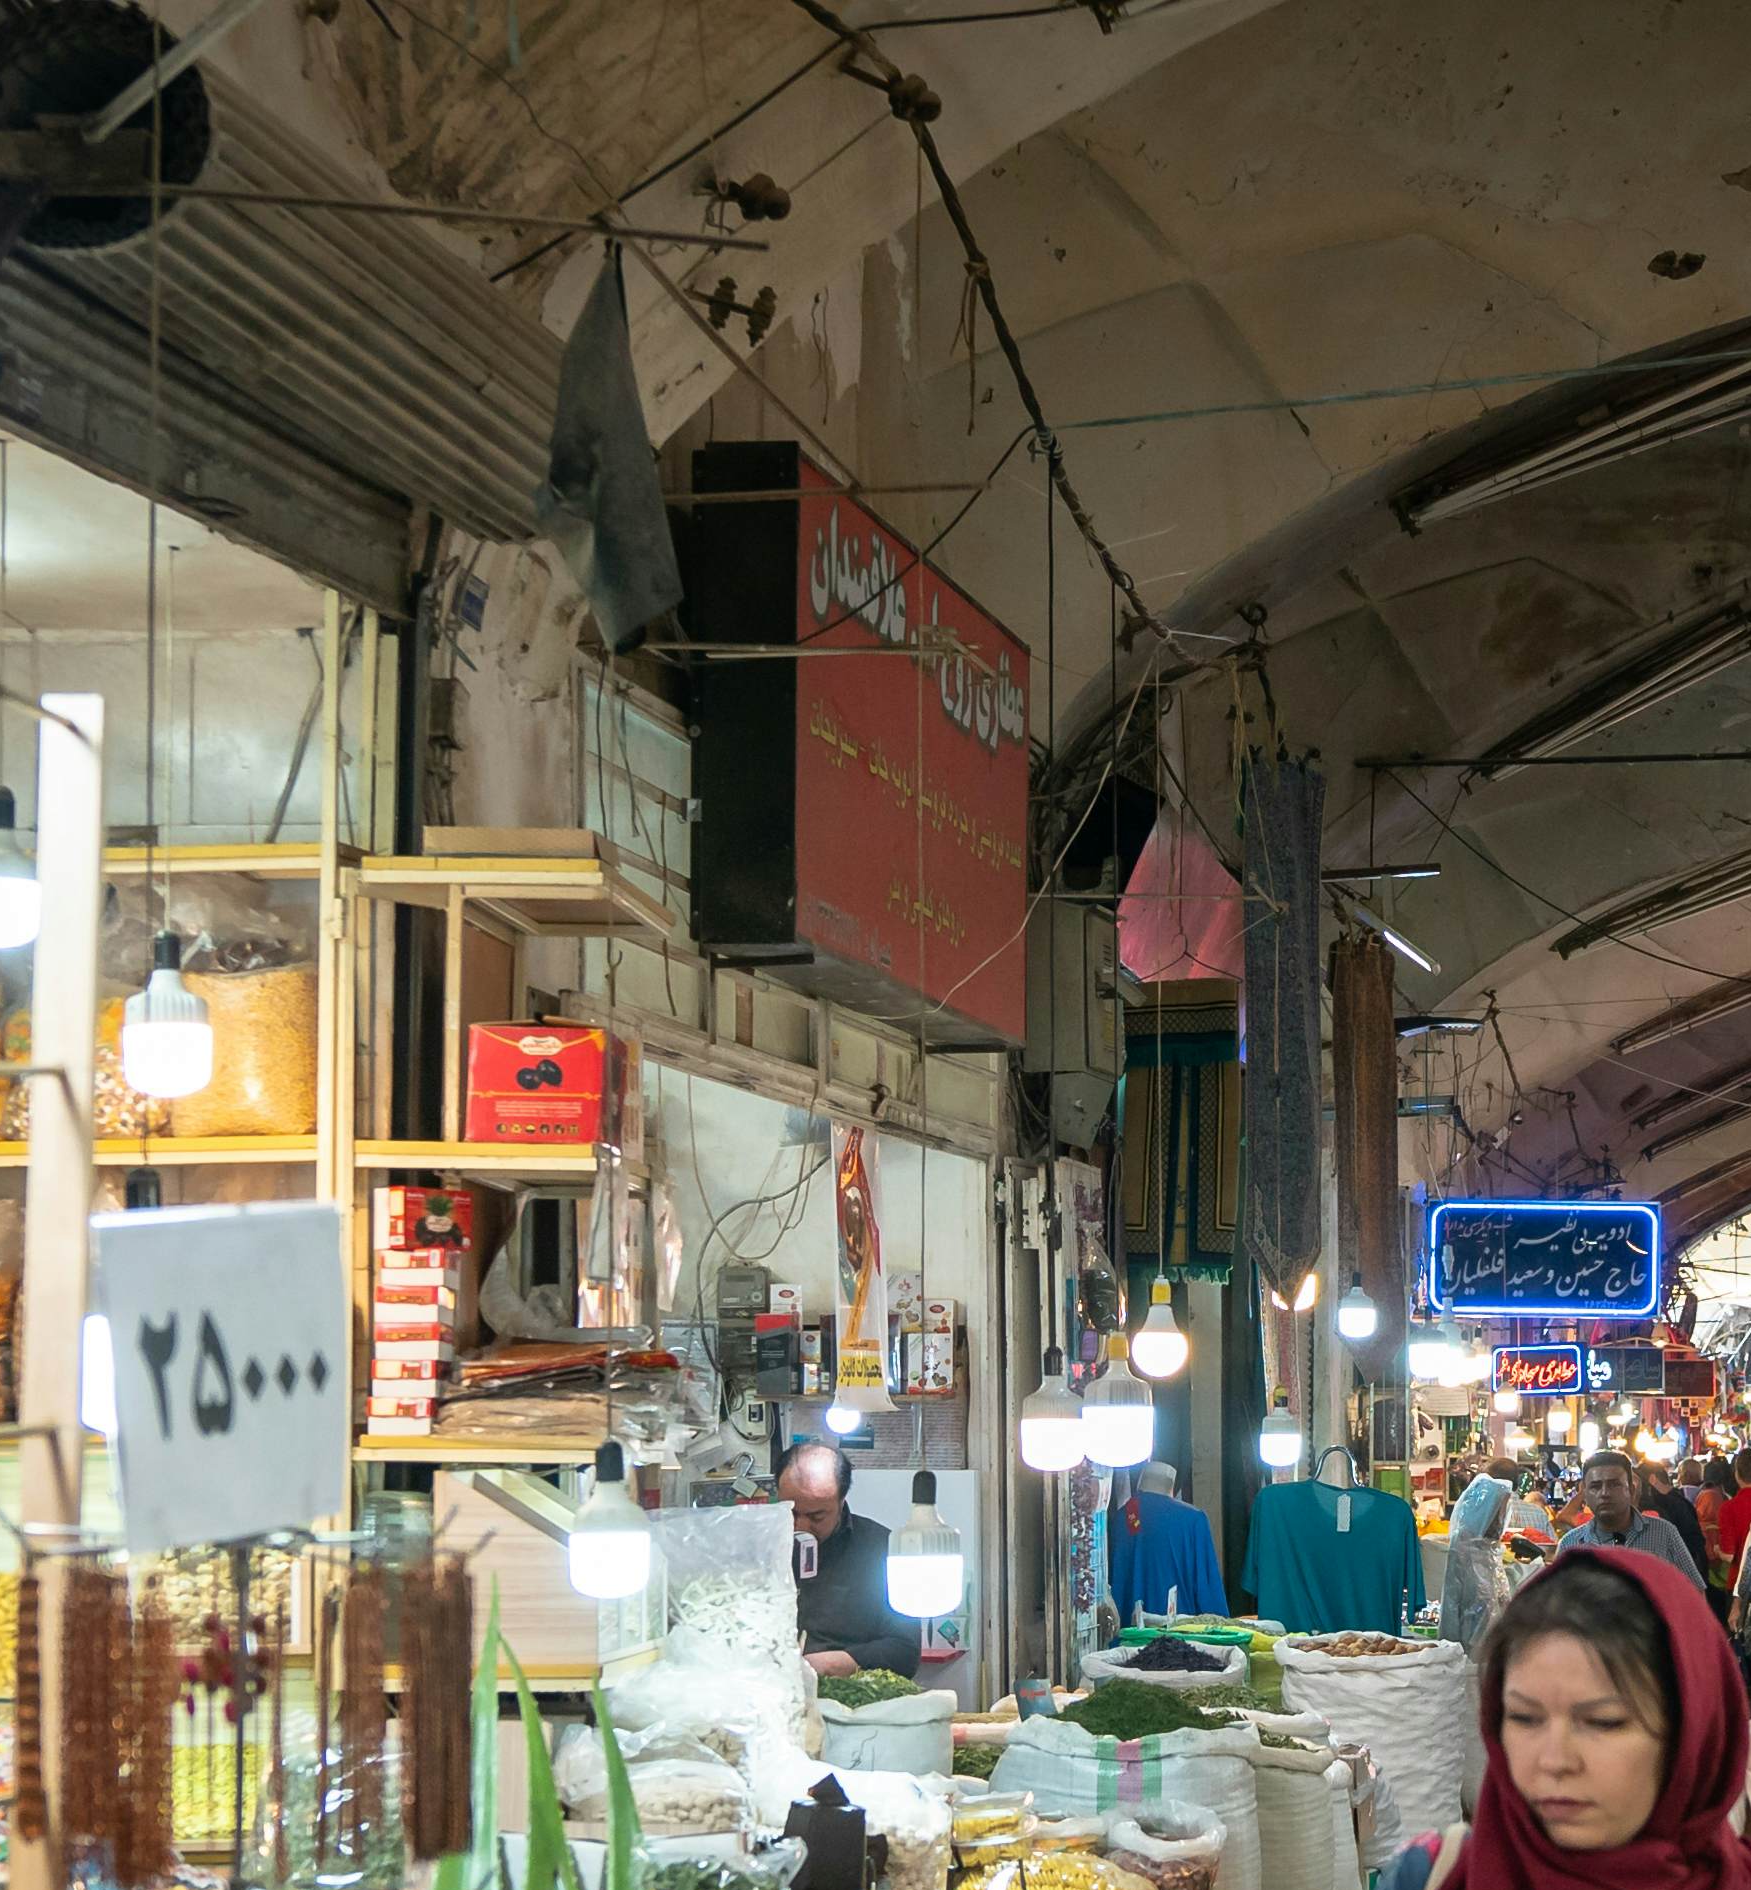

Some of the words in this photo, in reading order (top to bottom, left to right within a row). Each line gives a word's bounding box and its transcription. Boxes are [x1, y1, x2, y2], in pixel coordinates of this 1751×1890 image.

[810, 503, 907, 644] علاقمندان
[810, 701, 859, 770] سبزیجات
[1513, 1211, 1578, 1252] نظیر
[1572, 1228, 1597, 1256] بی
[1597, 1223, 1632, 1250] ادویه
[1507, 1264, 1545, 1298] سعید
[1545, 1268, 1556, 1285] و
[1555, 1258, 1606, 1298] حسین
[1604, 1259, 1649, 1299] حاج
[136, 1307, 330, 1441] ۲۵۰۰۰
